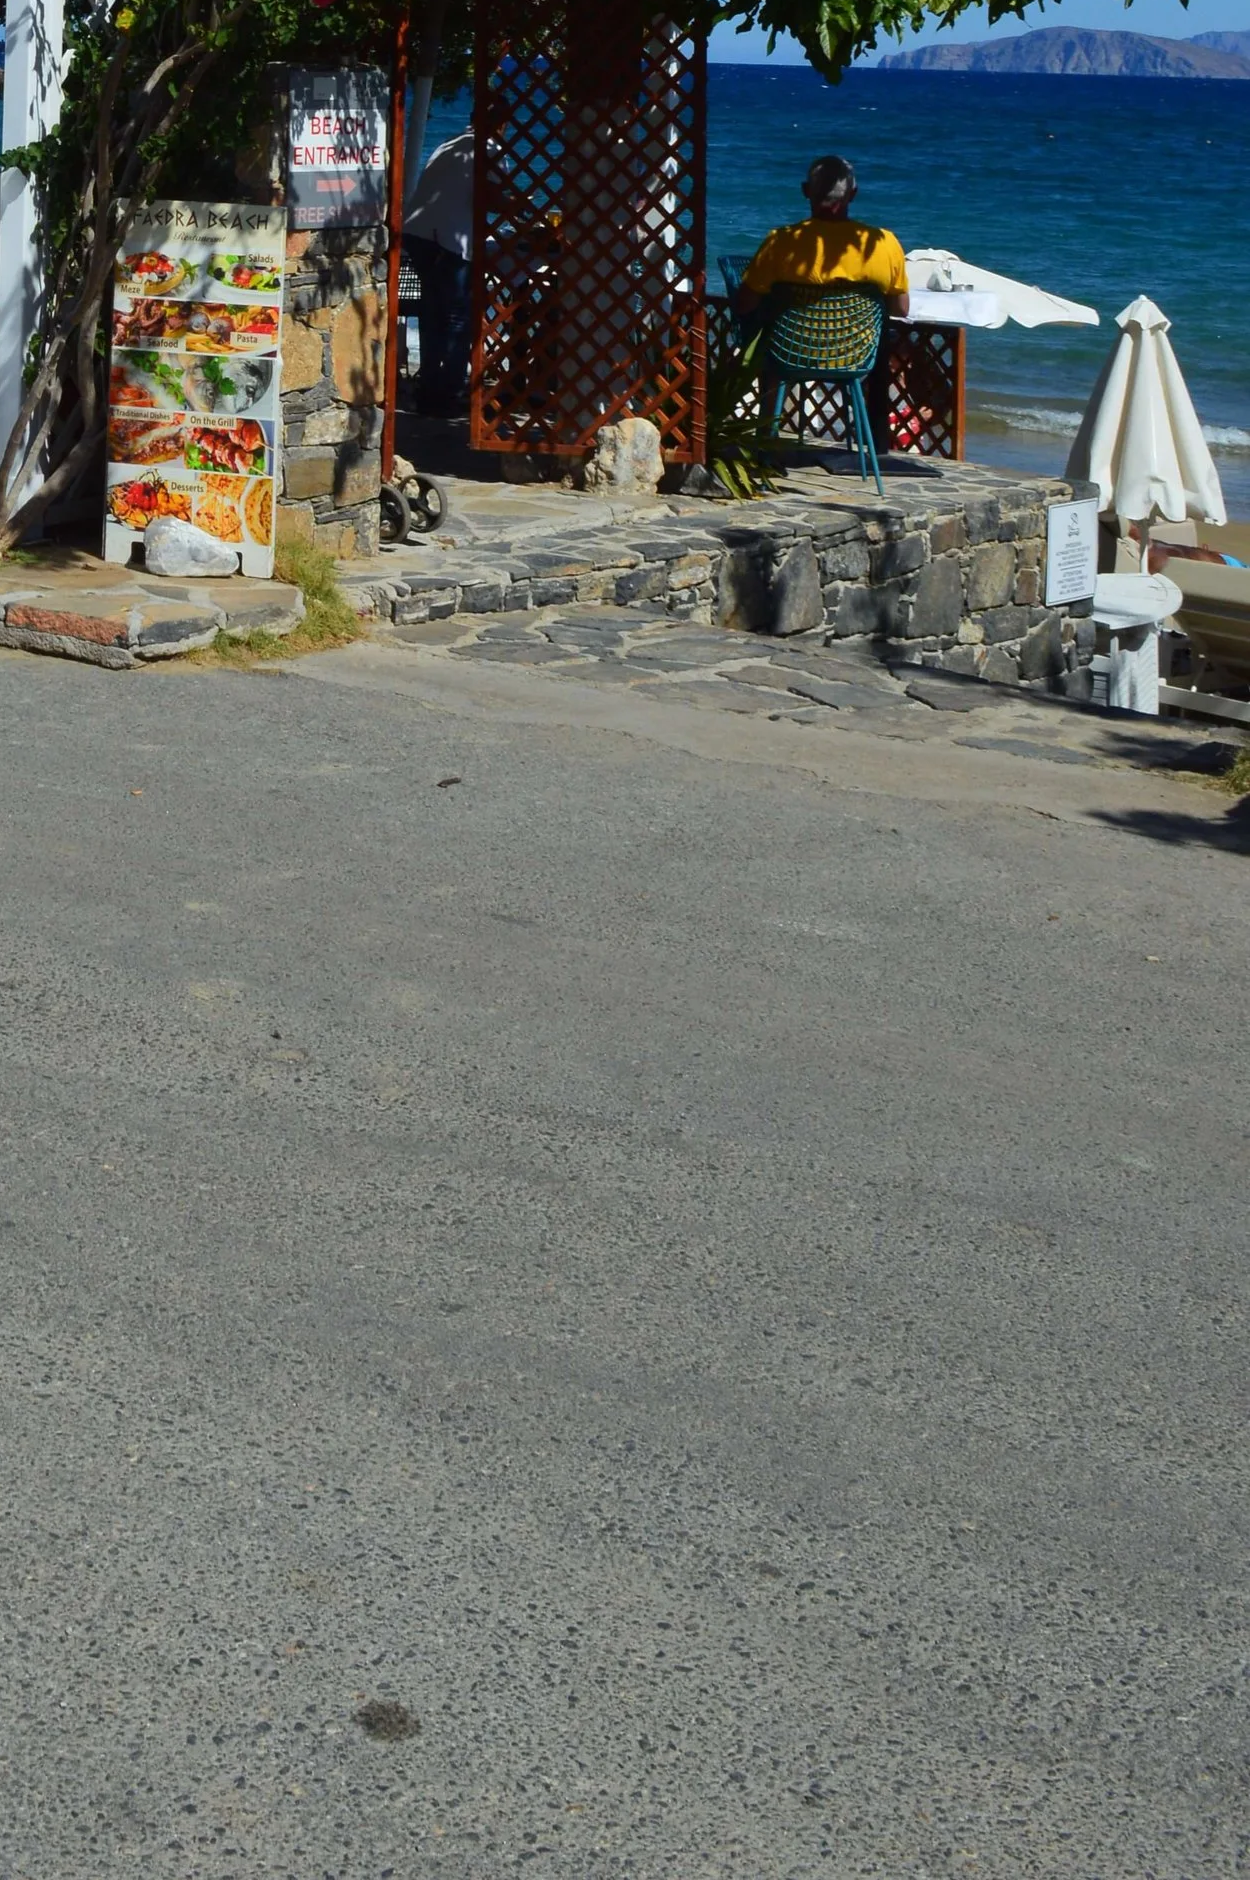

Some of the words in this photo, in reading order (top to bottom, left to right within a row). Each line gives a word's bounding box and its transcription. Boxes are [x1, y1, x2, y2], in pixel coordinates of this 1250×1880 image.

[310, 116, 366, 136] BEACH
[293, 146, 381, 166] ENTRANCE
[134, 208, 199, 228] FAEDRA
[207, 211, 269, 230] BEACH
[248, 253, 274, 264] Salads
[120, 284, 141, 294] Meze
[147, 337, 179, 349] Seafood
[236, 333, 258, 344] Pasta
[115, 408, 150, 419] Traditional
[150, 410, 170, 420] Dishes
[190, 415, 202, 425] On
[203, 416, 216, 426] the
[217, 416, 235, 428] Grill
[170, 481, 205, 493] Desserts
